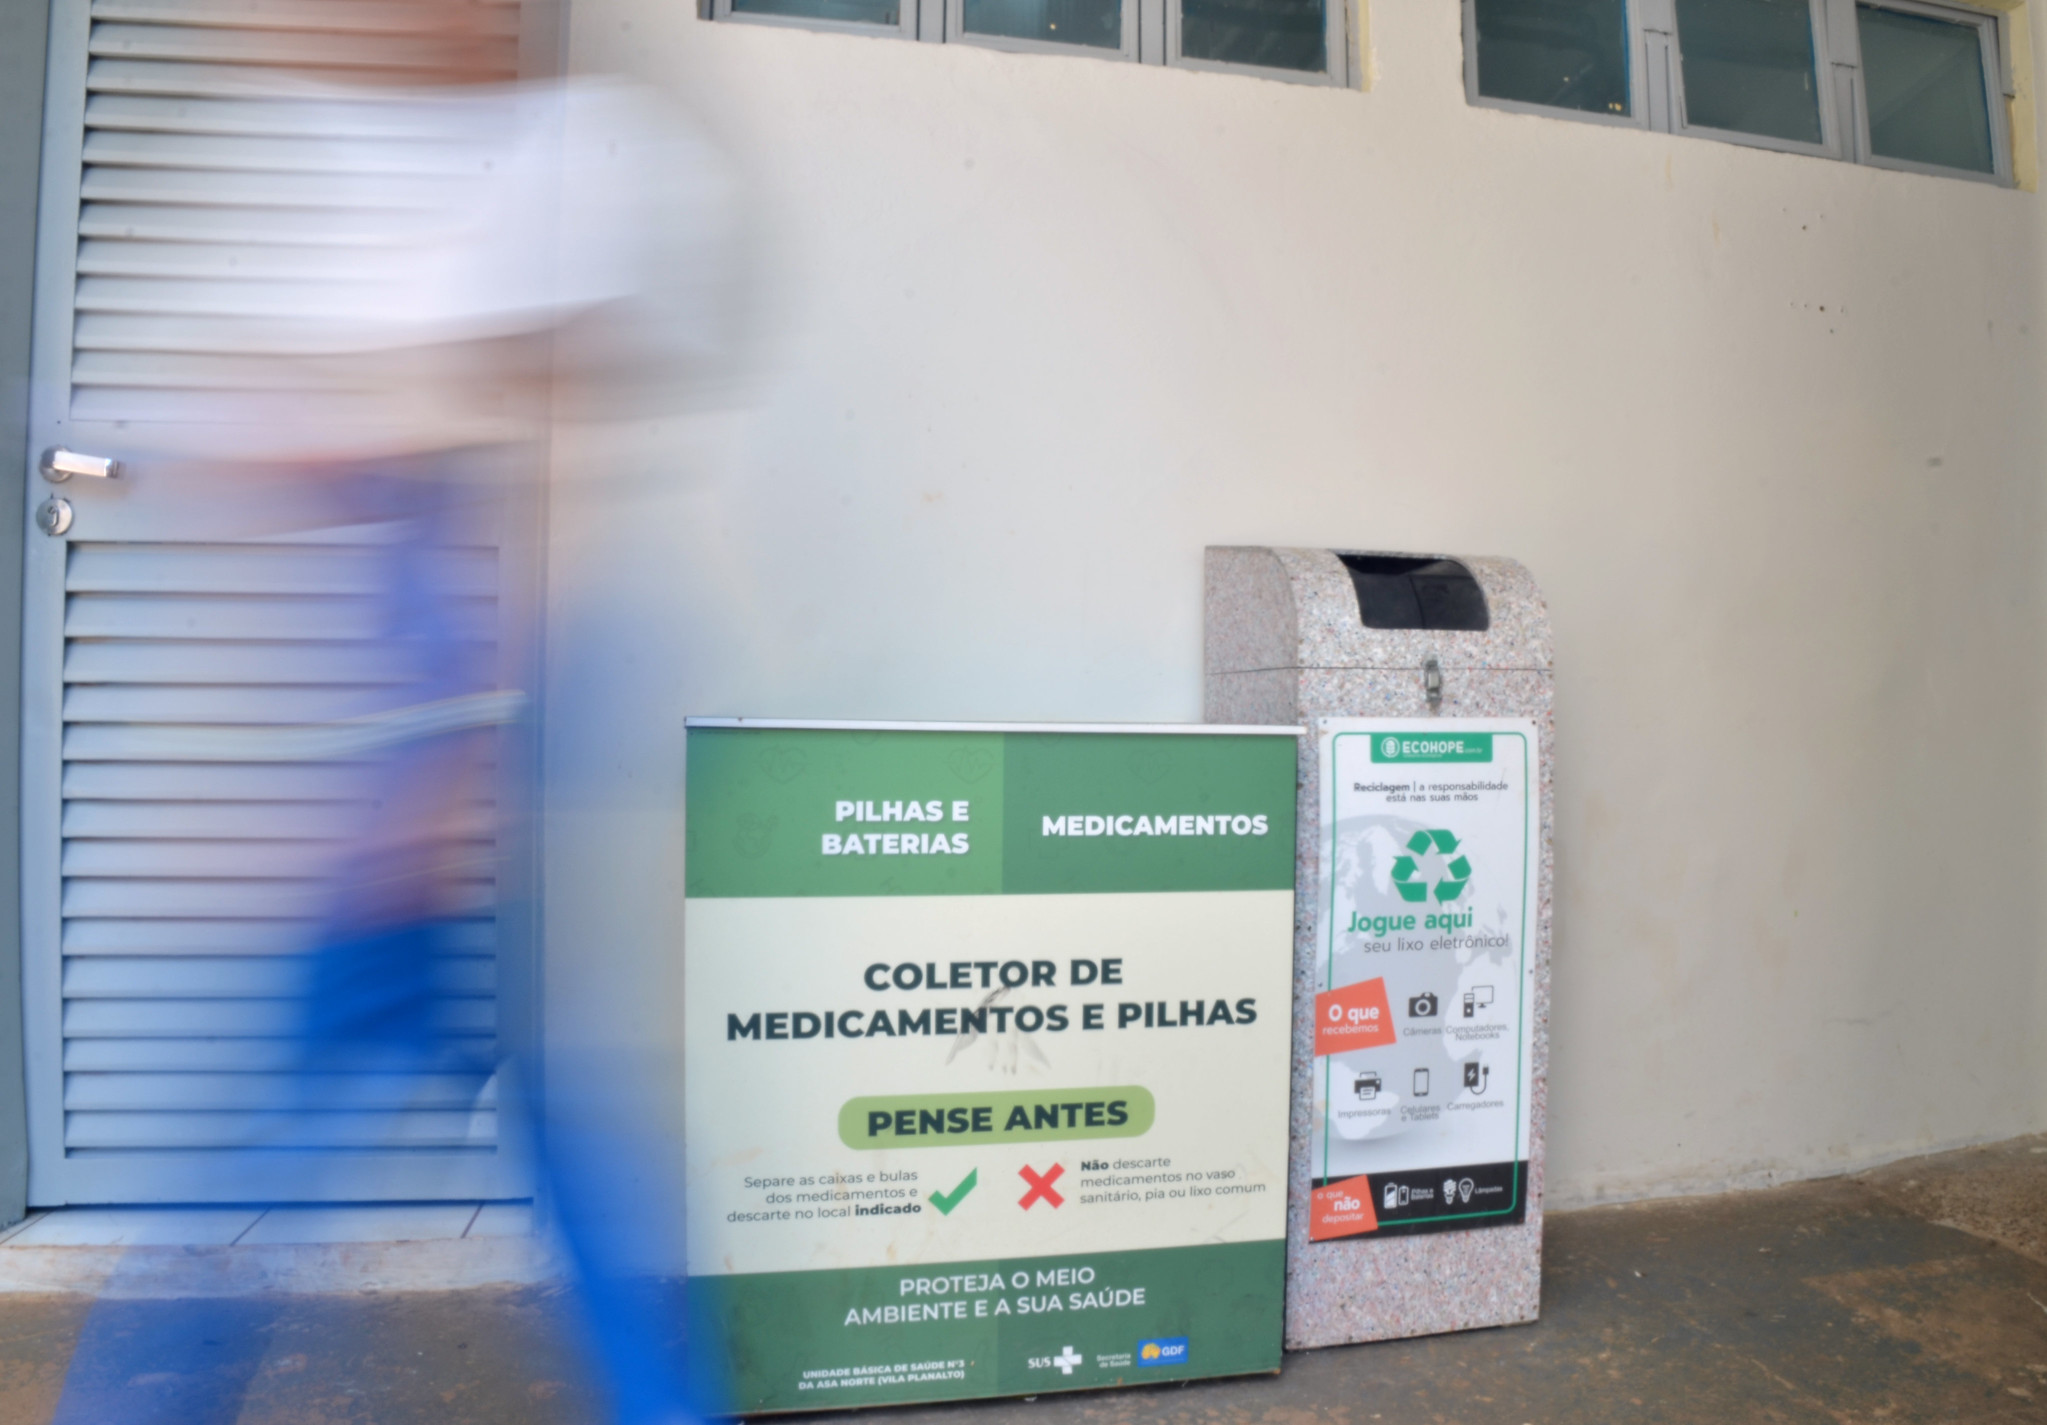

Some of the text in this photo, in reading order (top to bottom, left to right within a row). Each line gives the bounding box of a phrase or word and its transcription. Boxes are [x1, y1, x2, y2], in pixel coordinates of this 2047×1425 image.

[1402, 740, 1464, 754] ECOHOPE
[1353, 781, 1508, 794] Reciclagem a responsabilidade
[1386, 792, 1479, 802] está nas suas mãos
[835, 800, 970, 822] PILHAS E
[1042, 814, 1269, 837] MEDICAMENTOS
[821, 832, 970, 856] BATERIAS
[1347, 906, 1473, 937] Jogue aqui
[1364, 934, 1509, 953] seu lixo eletrônico!
[863, 958, 1124, 992] COLETOR DE
[726, 998, 1258, 1041] MEDICAMENTOS E PILHAS
[1328, 1003, 1380, 1023] O que
[1322, 1023, 1379, 1035] recebemos
[1403, 1026, 1442, 1037] Câmeras
[1445, 1023, 1509, 1035] Computadores,
[1455, 1030, 1500, 1041] Notebooks
[1337, 1106, 1392, 1119] Impressoras
[1400, 1103, 1441, 1115] Celulares
[1446, 1098, 1504, 1112] Carregadores
[867, 1100, 1129, 1137] PENSE ANTES
[1401, 1110, 1439, 1122] e Tablets
[1080, 1156, 1171, 1171] Não descarte
[744, 1169, 918, 1190] Separe as caixas e bulas
[1080, 1169, 1236, 1188] medicamentos no vaso
[765, 1187, 918, 1204] dos medicamentos e
[1080, 1182, 1266, 1204] sanitário, pia ou lixo comum
[1317, 1190, 1344, 1200] o que
[1334, 1196, 1361, 1212] não
[727, 1202, 922, 1223] descarte no local indicado
[1322, 1213, 1364, 1225] depositar
[900, 1266, 1096, 1296] PROTEJA O MEIO
[844, 1286, 1146, 1326] AMBIENTE E A SUA SAÚDE
[1161, 1345, 1185, 1357] GDF
[802, 1368, 851, 1379] UNIDADE
[853, 1364, 892, 1376] BÁSICA
[894, 1362, 908, 1372] DE
[910, 1359, 945, 1371] SAÚDE
[1028, 1356, 1051, 1369] SUS
[1099, 1360, 1108, 1368] de
[798, 1370, 965, 1390] DA ASA NORTE (VILA PLANALTO)
